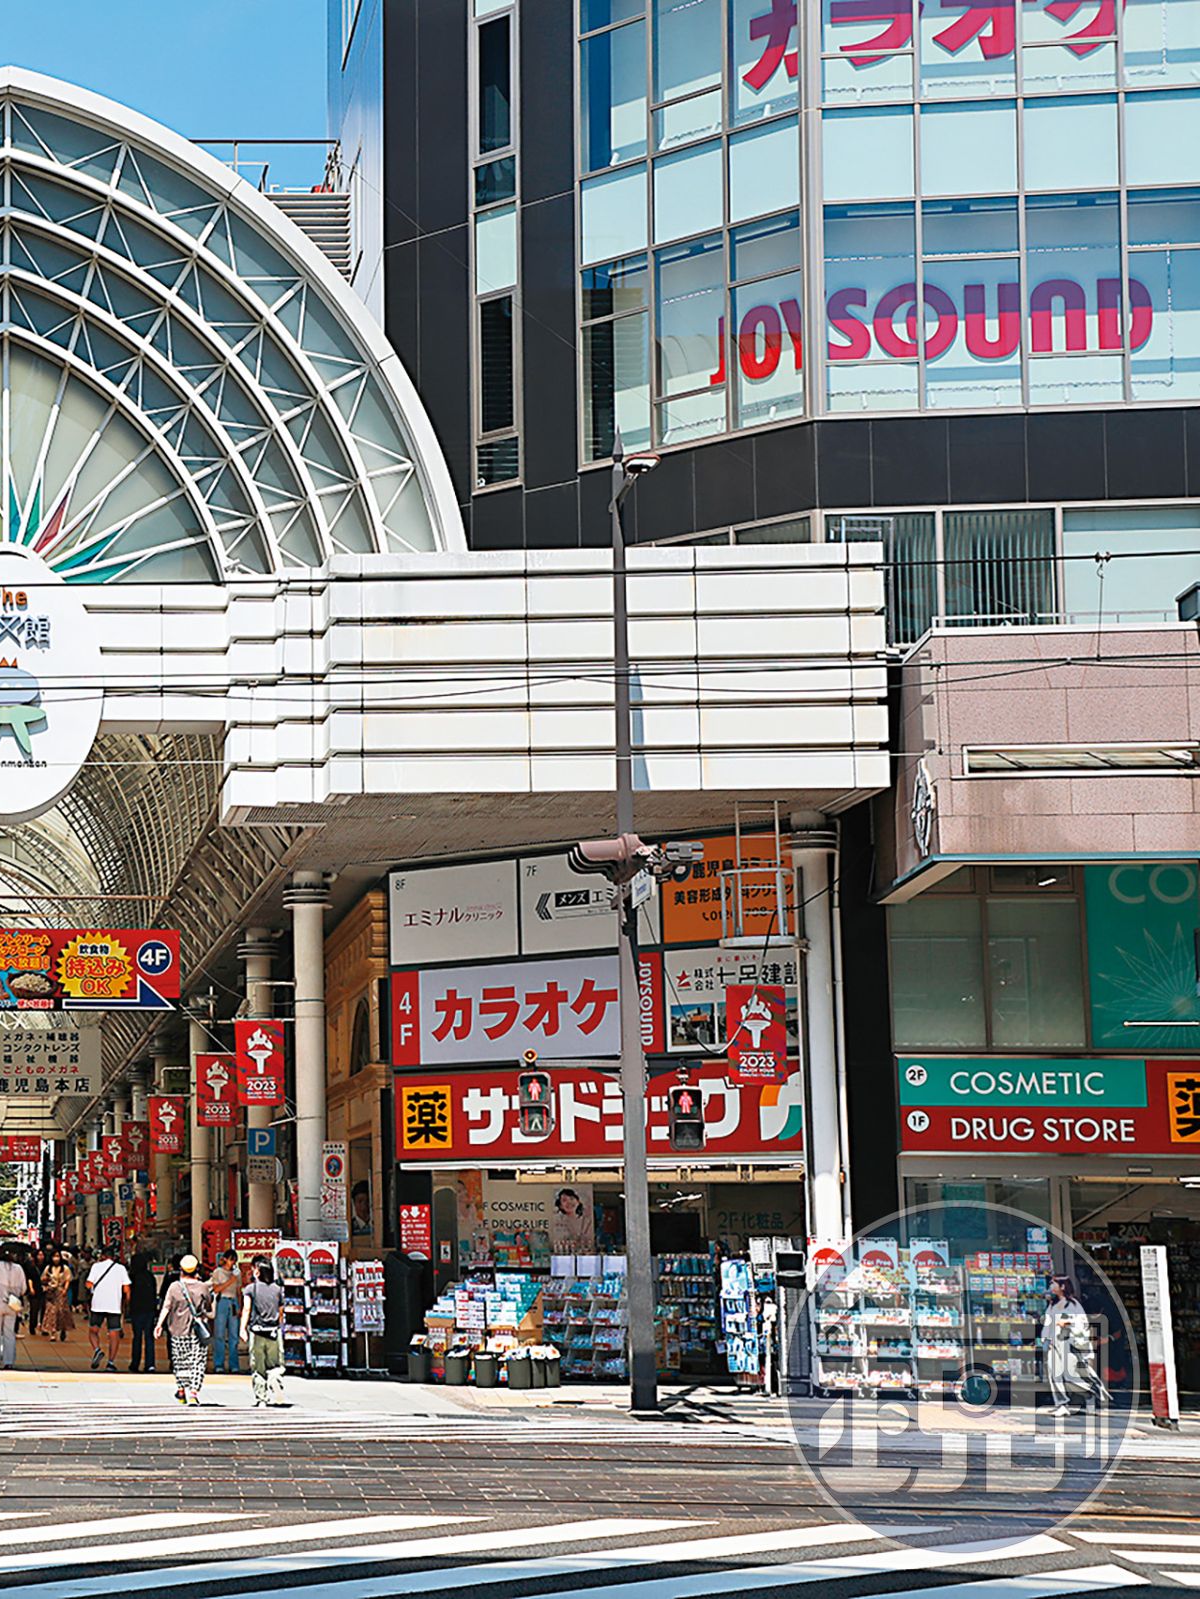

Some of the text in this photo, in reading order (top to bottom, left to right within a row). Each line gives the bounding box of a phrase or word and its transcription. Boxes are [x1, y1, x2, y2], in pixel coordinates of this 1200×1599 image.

[710, 278, 1153, 384] JOYSOUND
[526, 865, 537, 877] 7F
[559, 892, 586, 905] メンズ
[141, 948, 167, 966] 4F
[66, 957, 126, 977] 持込み
[81, 979, 111, 994] OK
[431, 978, 619, 1042] カラオケ
[639, 962, 653, 1046] JOYSOUND
[3, 1043, 79, 1053] コンタクトレンズ
[739, 1056, 776, 1068] 2023
[908, 1070, 924, 1080] 2F
[247, 1081, 277, 1091] 2023
[950, 1071, 1105, 1095] COSMETIC
[205, 1106, 230, 1114] 2023
[407, 1091, 448, 1144] 薬
[911, 1115, 926, 1127] 1F
[951, 1118, 1136, 1142] DRUG STORE
[255, 1132, 270, 1153] P
[491, 1202, 545, 1211] COSMETIC
